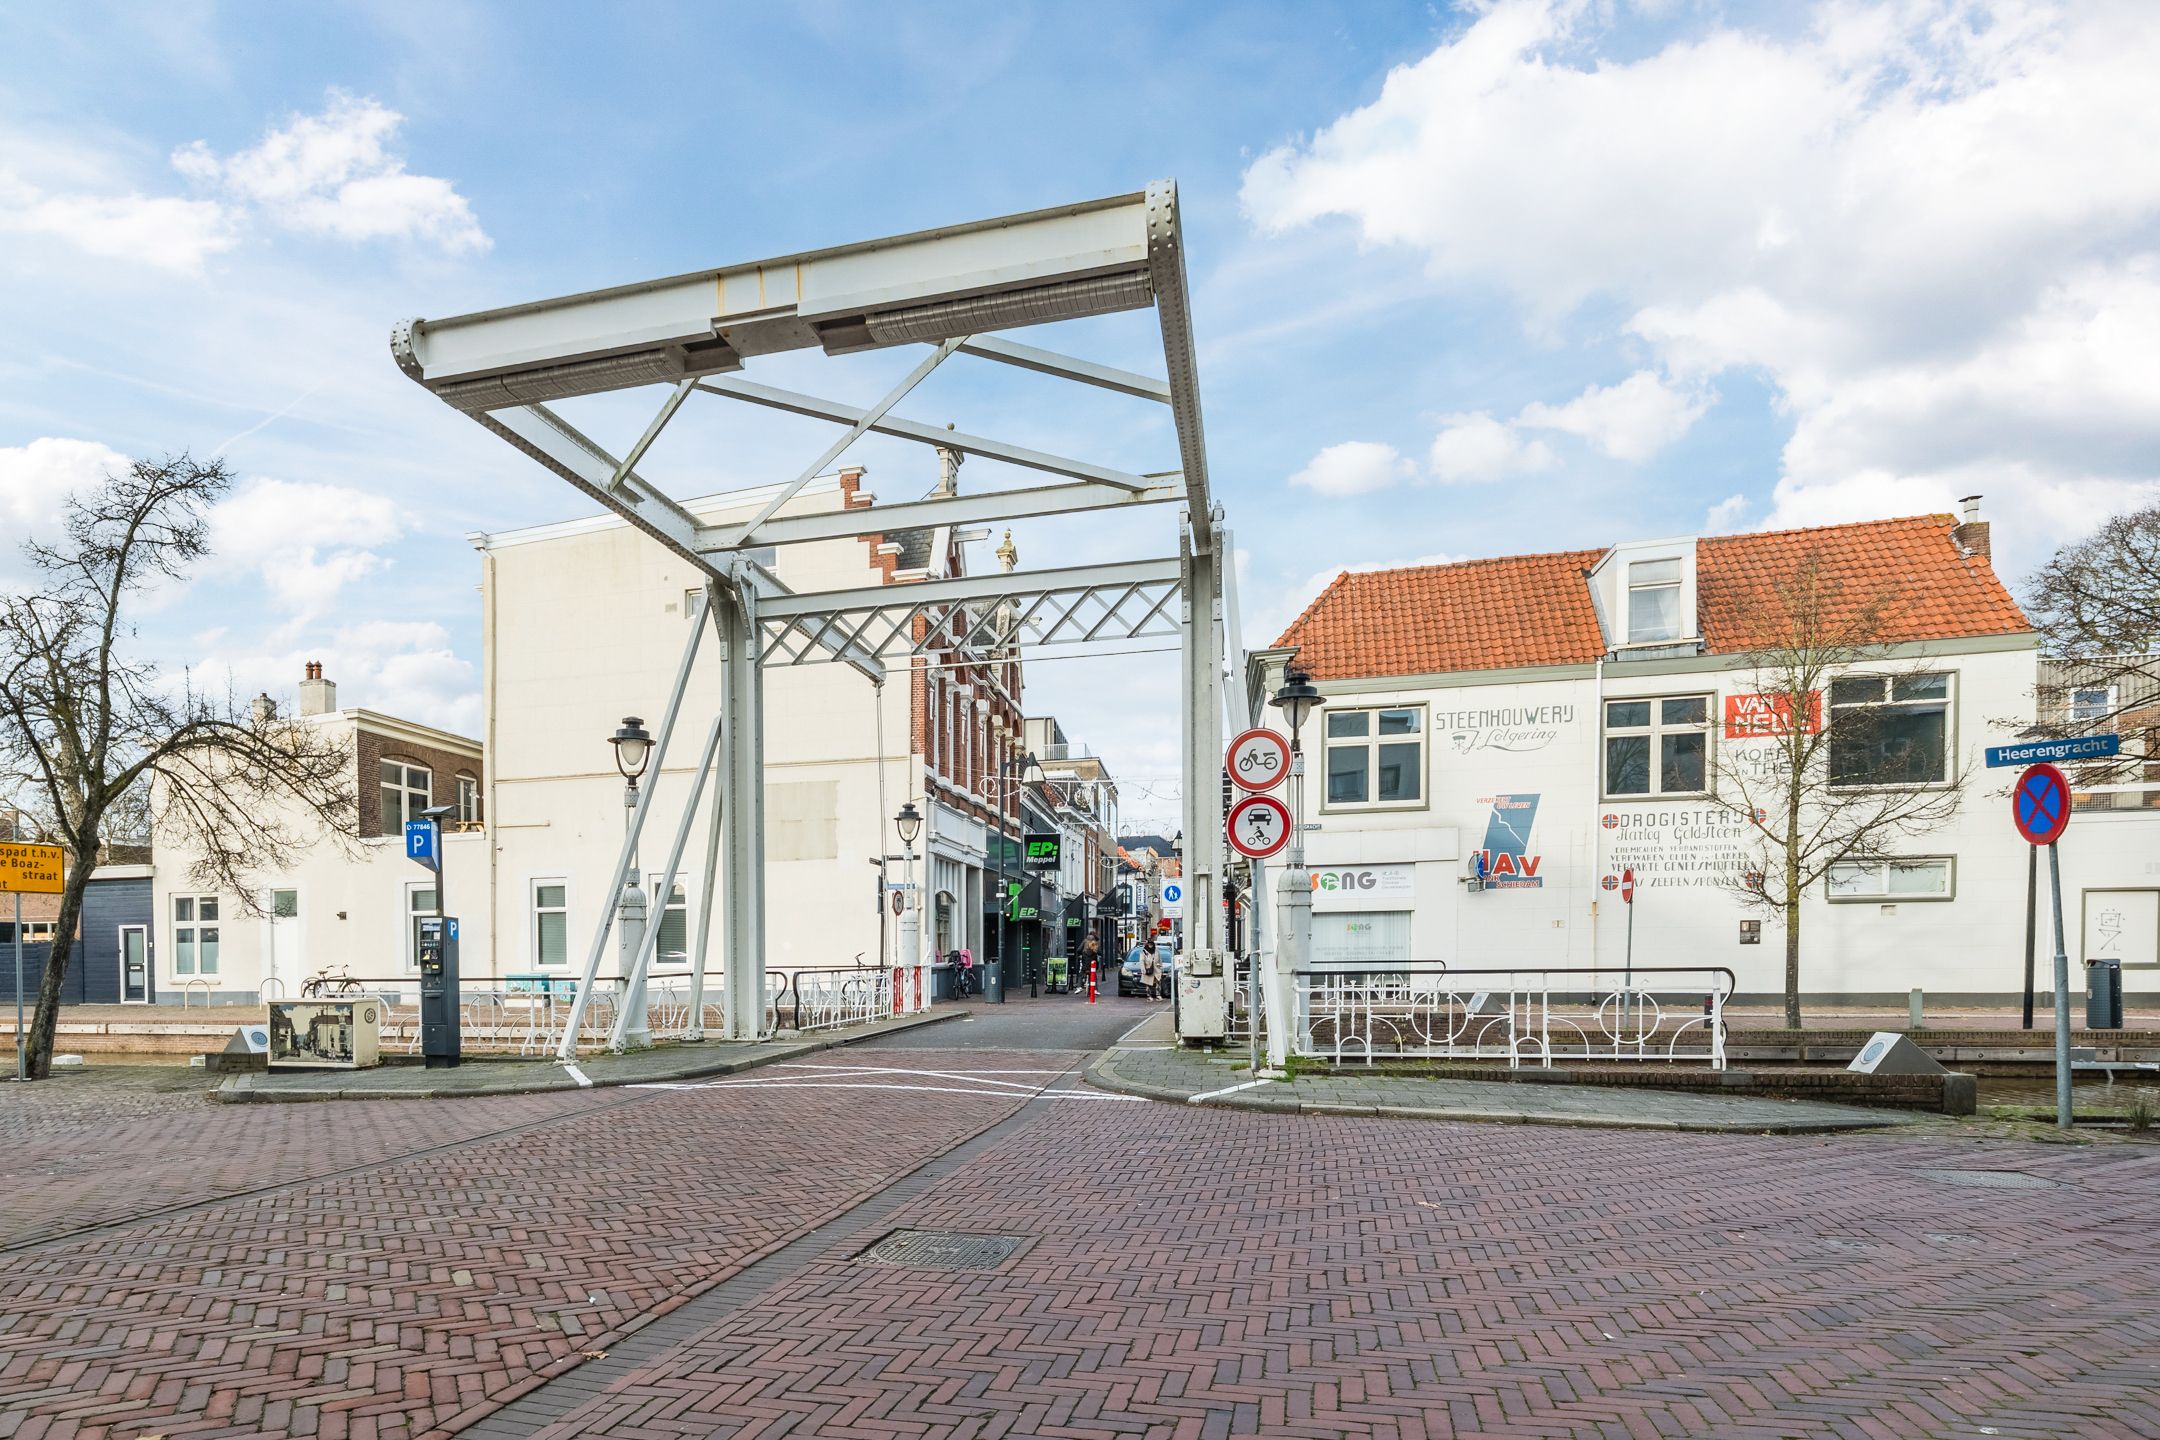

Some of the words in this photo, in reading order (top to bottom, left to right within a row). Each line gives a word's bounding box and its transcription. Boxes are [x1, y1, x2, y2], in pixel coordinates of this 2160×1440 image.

[1735, 695, 1774, 714] VAN
[1436, 705, 1574, 730] STEENHOUWERIJ
[1477, 728, 1558, 752] Lolgering
[1998, 739, 2109, 761] Heerengracht
[1620, 810, 1744, 828] DROGISTERIJ
[413, 835, 424, 854] P
[1028, 842, 1059, 855] EP:
[32, 849, 60, 859] t.h.v.
[1026, 856, 1056, 864] Meppel
[11, 858, 45, 869] Boaz-
[1664, 861, 1757, 871] GENEESMIDDELEN
[22, 871, 58, 881] straat
[1650, 877, 1690, 887] ZEEPEN
[1692, 877, 1739, 887] SPONSEN
[1496, 880, 1538, 888] SCHIEDAM
[1020, 907, 1038, 916] EP:
[450, 922, 457, 936] P
